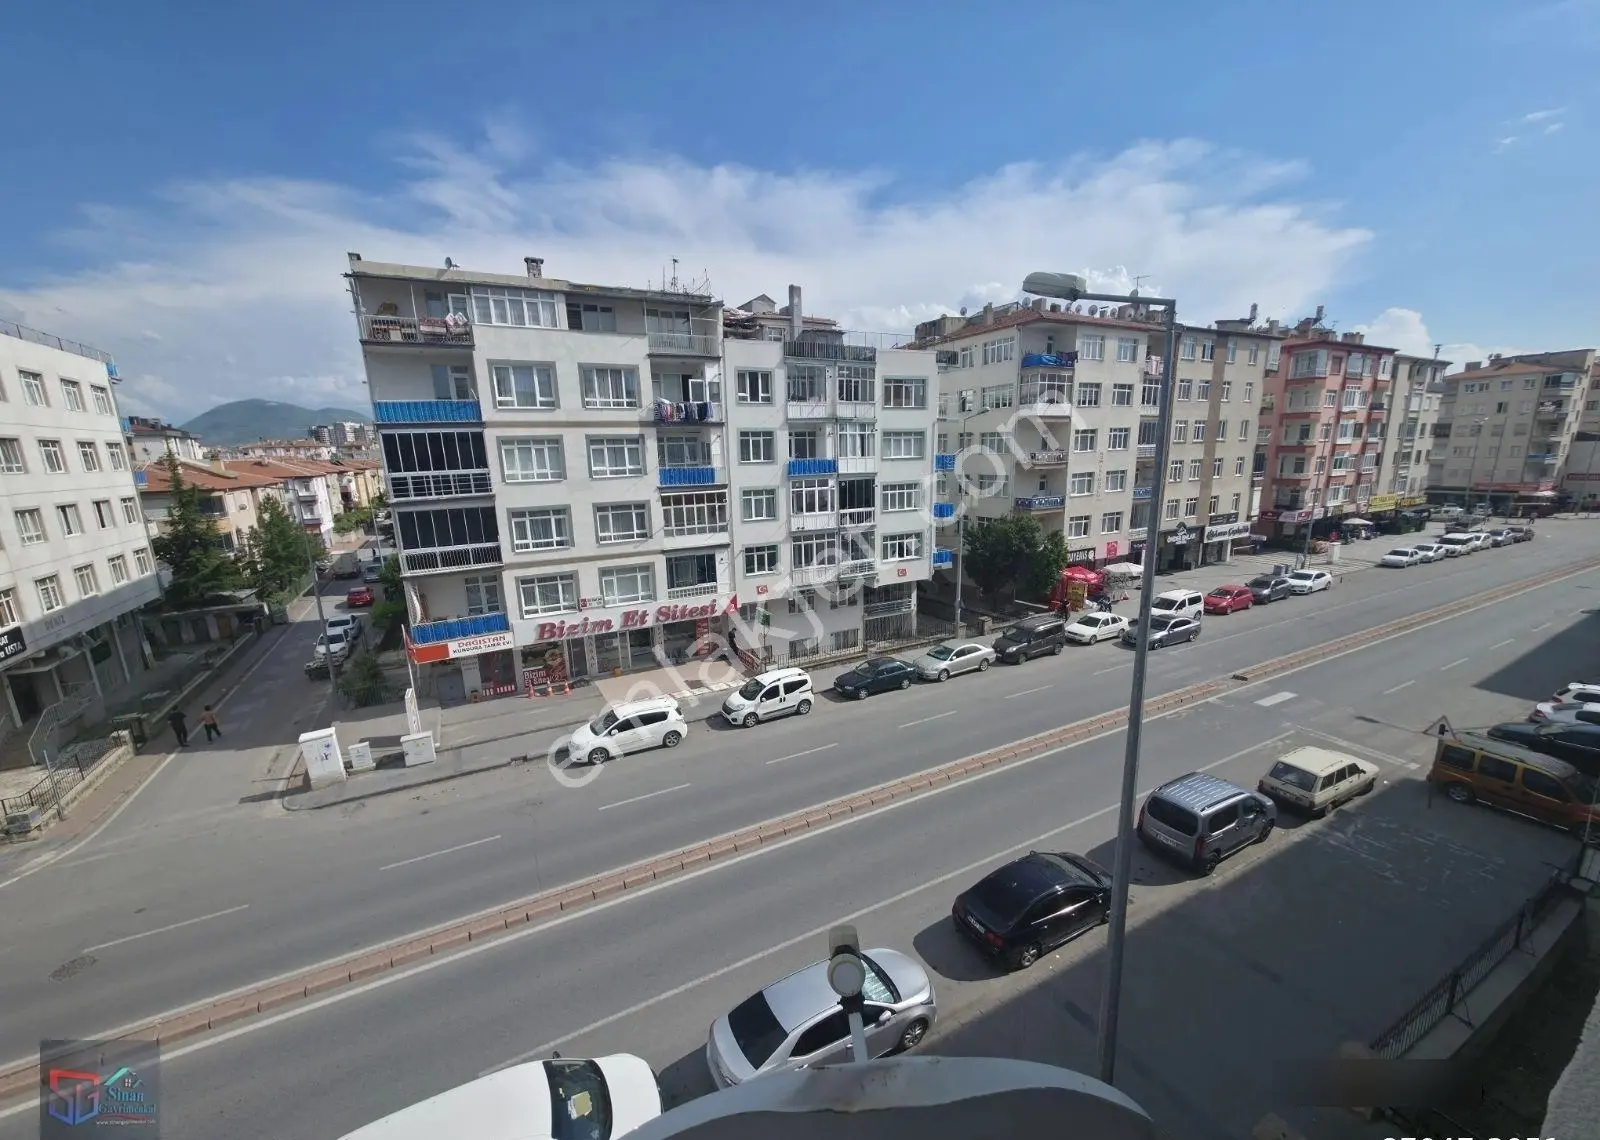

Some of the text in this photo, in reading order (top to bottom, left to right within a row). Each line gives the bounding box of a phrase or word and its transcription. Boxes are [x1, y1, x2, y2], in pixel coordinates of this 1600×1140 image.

[535, 598, 718, 641] Bizim Et Sitesi
[5, 641, 23, 655] USTA
[524, 670, 547, 680] Bizim
